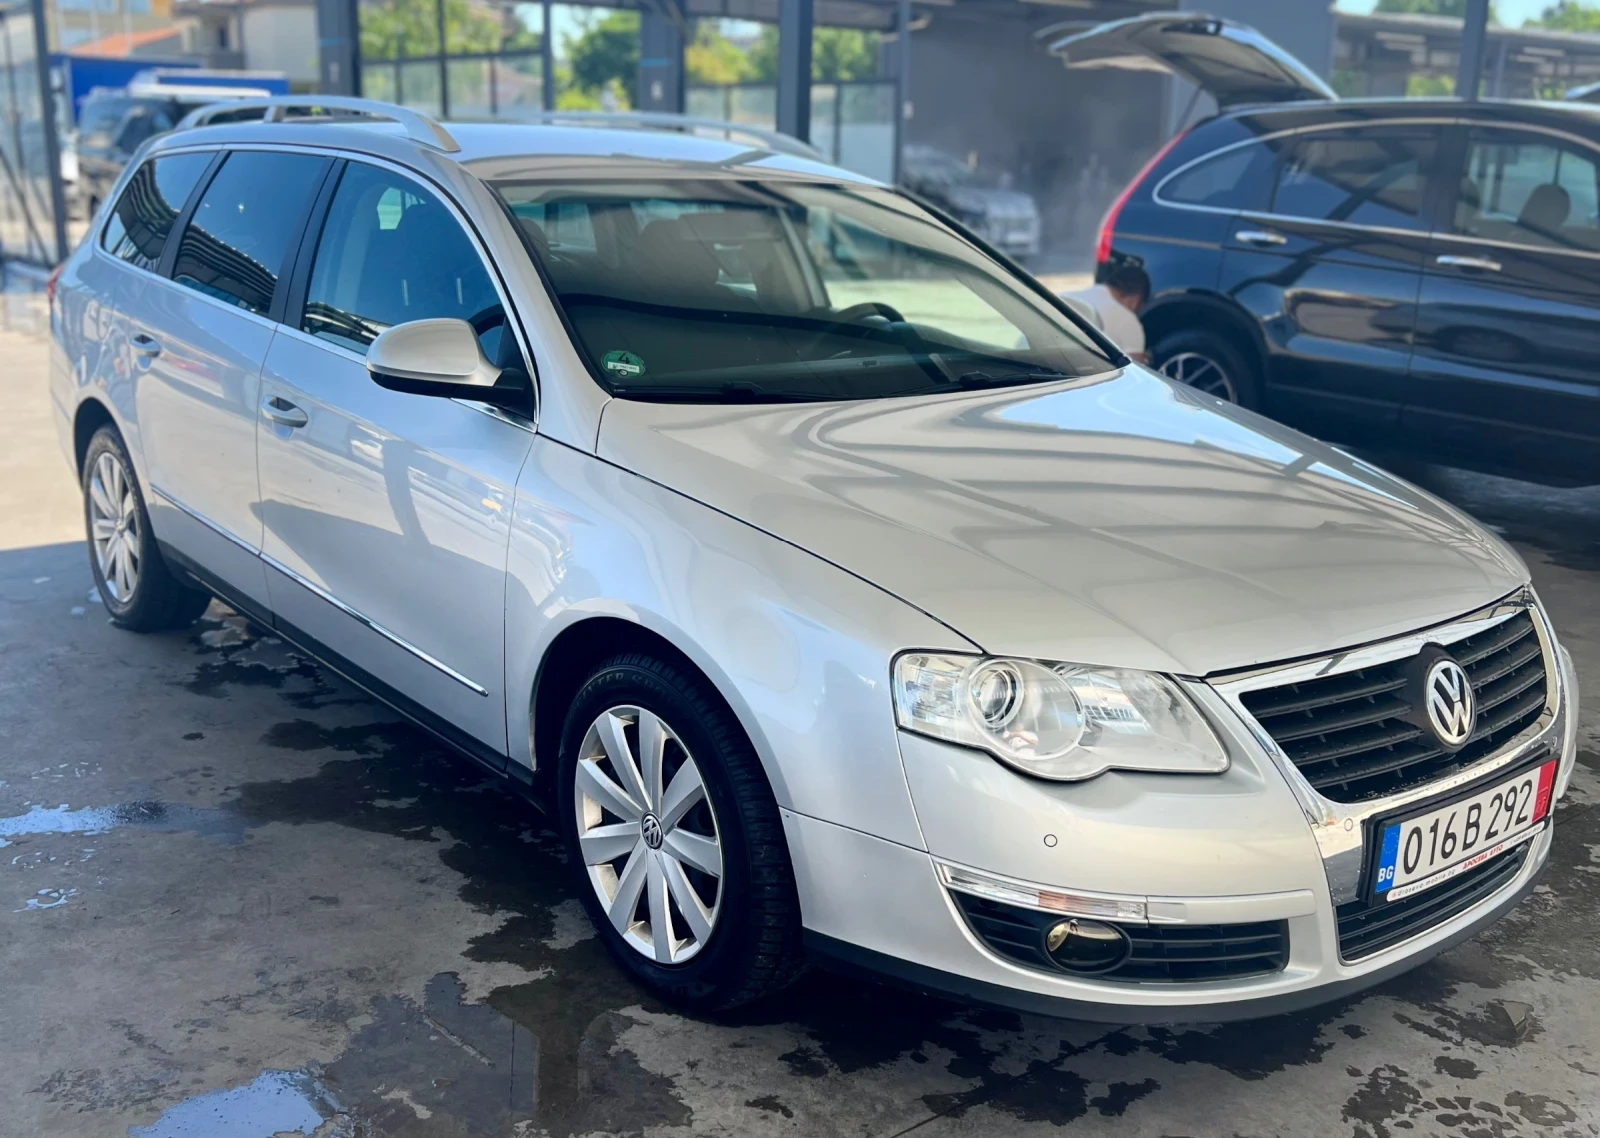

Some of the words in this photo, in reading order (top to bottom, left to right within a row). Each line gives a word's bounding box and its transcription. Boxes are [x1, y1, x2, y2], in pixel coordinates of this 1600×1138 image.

[618, 353, 630, 364] 4
[1403, 779, 1533, 875] 016B292
[1377, 865, 1395, 883] BG
